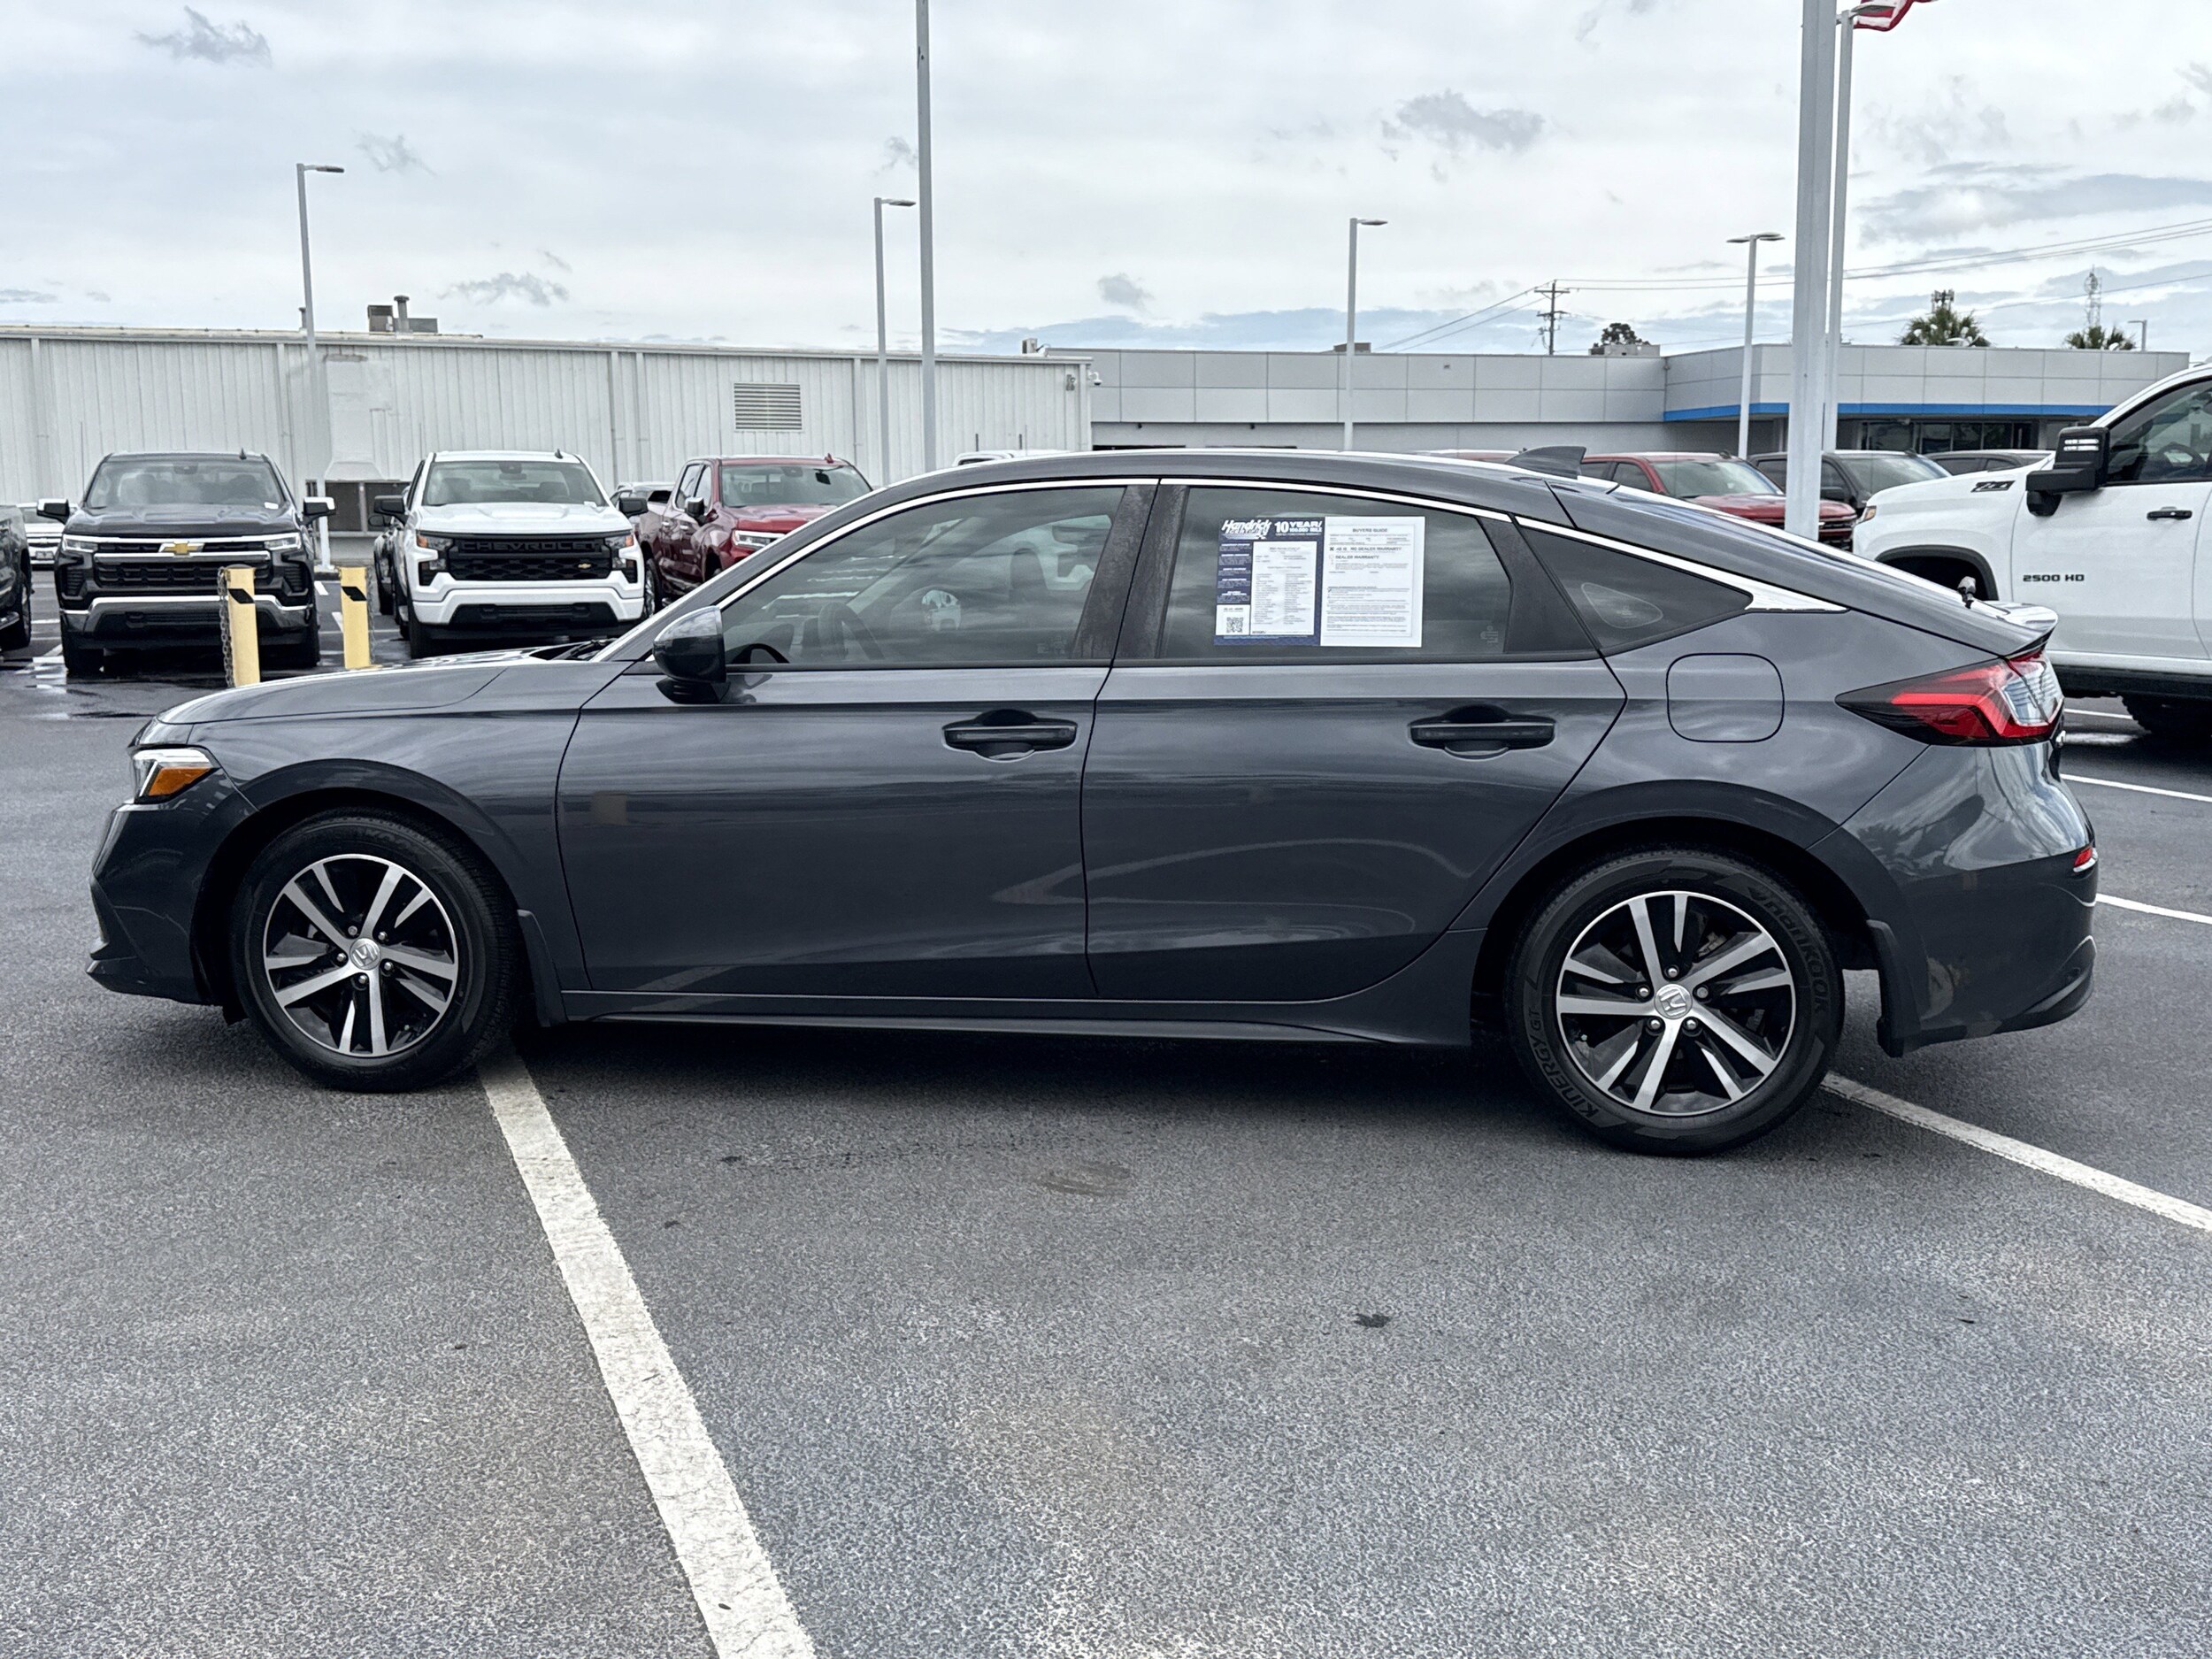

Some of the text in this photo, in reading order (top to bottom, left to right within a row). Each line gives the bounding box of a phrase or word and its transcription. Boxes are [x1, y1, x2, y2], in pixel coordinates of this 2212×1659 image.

[1221, 519, 1272, 536] Hendrick
[1274, 521, 1289, 533] 10
[462, 541, 597, 551] CHEVROLET
[1530, 1011, 1600, 1118] KINERGY GT
